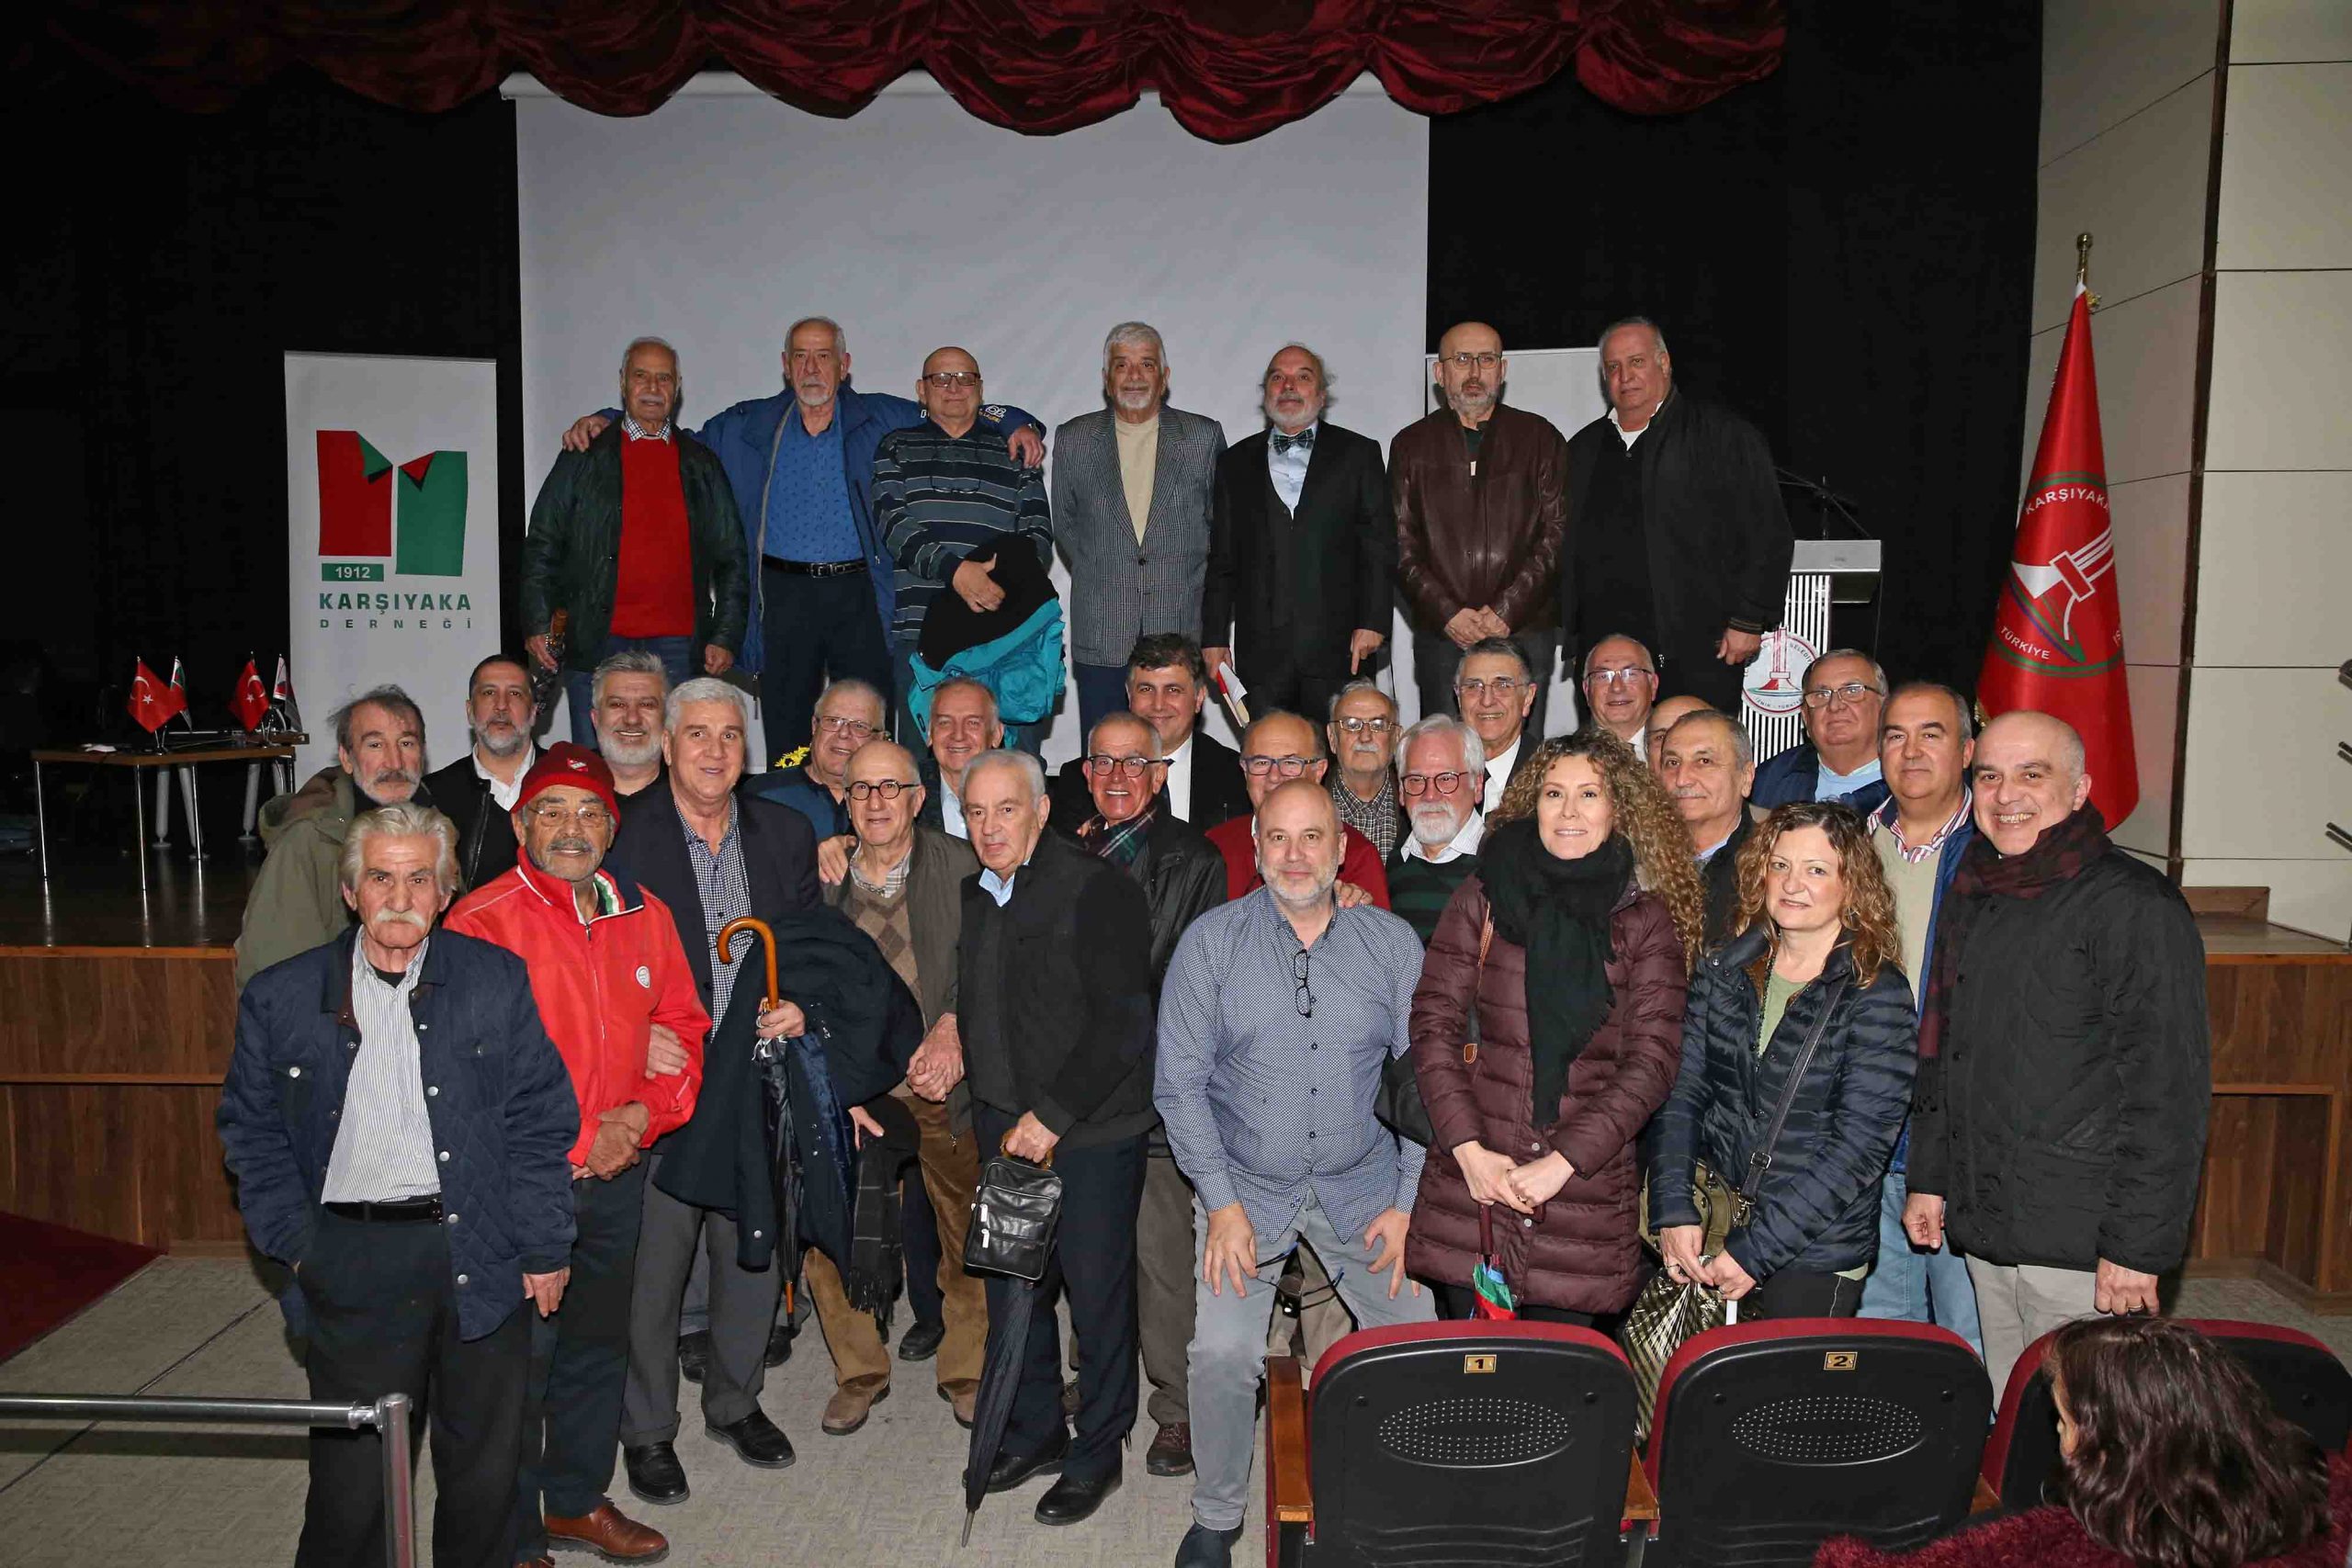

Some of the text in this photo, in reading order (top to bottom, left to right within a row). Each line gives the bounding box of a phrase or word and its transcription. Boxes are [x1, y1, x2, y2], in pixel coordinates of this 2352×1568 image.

[335, 566, 371, 579] 1912
[319, 592, 471, 615] KARŞIYAKA
[320, 617, 471, 628] DERNEĞİ
[2000, 626, 2051, 660] TÜRKİYE
[1475, 1359, 1485, 1370] 1
[1833, 1355, 1849, 1367] 2
